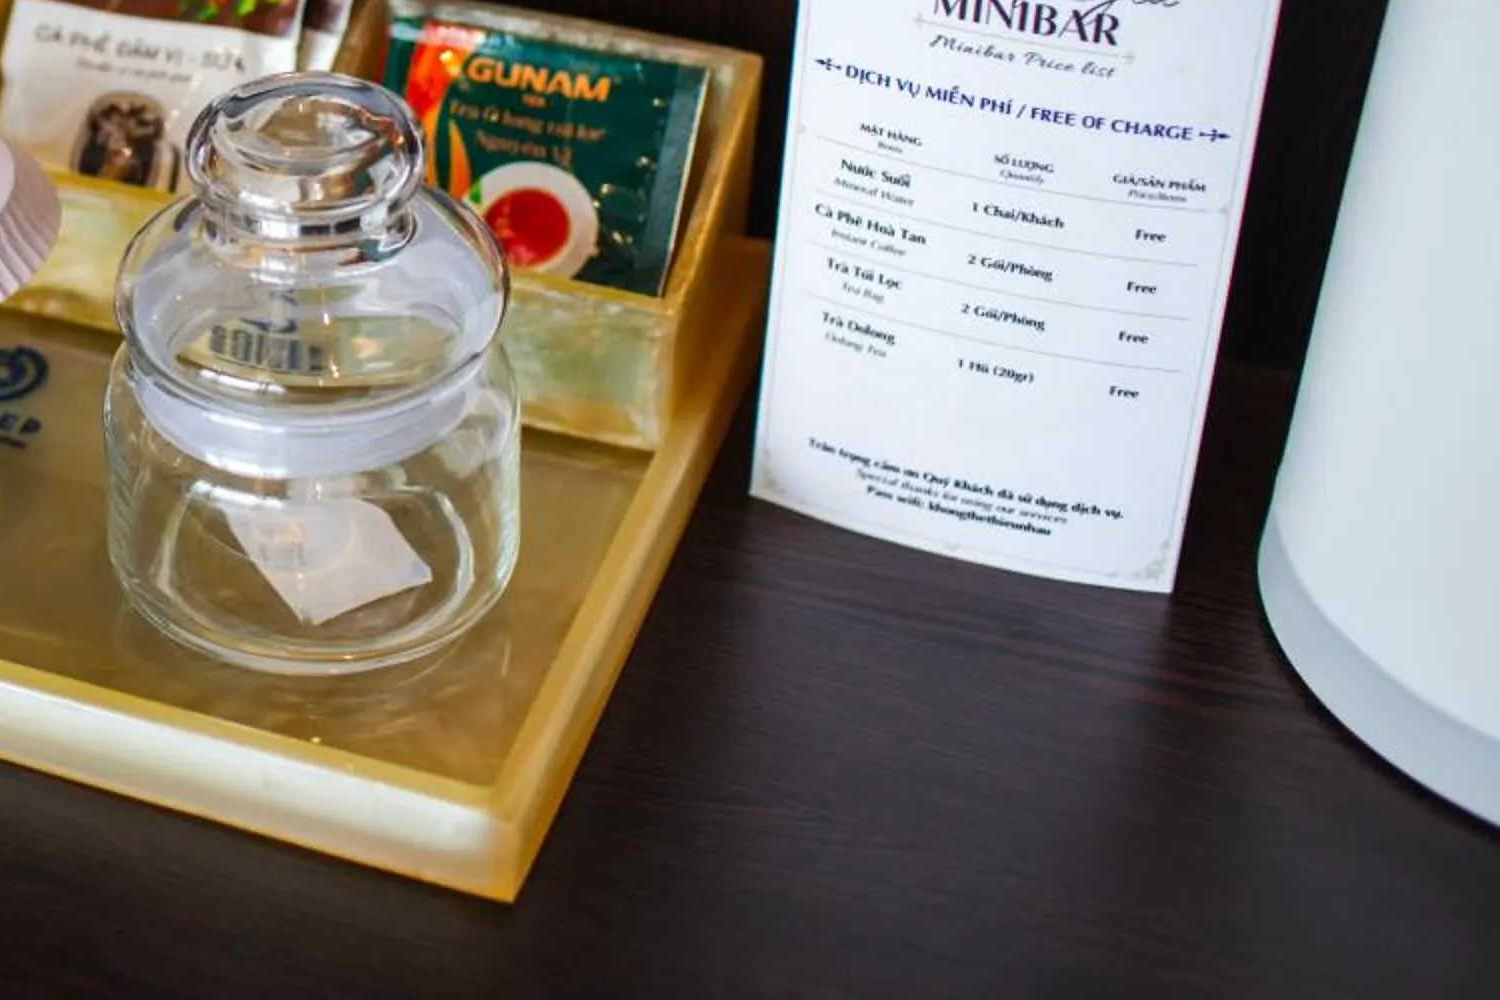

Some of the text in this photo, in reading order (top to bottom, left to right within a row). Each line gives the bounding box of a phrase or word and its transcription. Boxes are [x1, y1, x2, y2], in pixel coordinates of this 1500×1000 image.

[930, 34, 1116, 78] Minibar Price list
[467, 56, 612, 103] GUNAM
[845, 65, 891, 87] DỊCH
[896, 77, 921, 98] VỤ
[979, 96, 1012, 115] PHÍ
[1016, 104, 1027, 118] /
[1030, 107, 1076, 126] FREE
[1081, 115, 1106, 130] OF
[1110, 119, 1194, 141] CHARGE
[900, 228, 927, 245] Tan
[1135, 229, 1167, 243] Free
[968, 253, 977, 265] 2
[1126, 281, 1157, 295] Free
[1118, 331, 1149, 345] Free
[1109, 385, 1140, 399] Free
